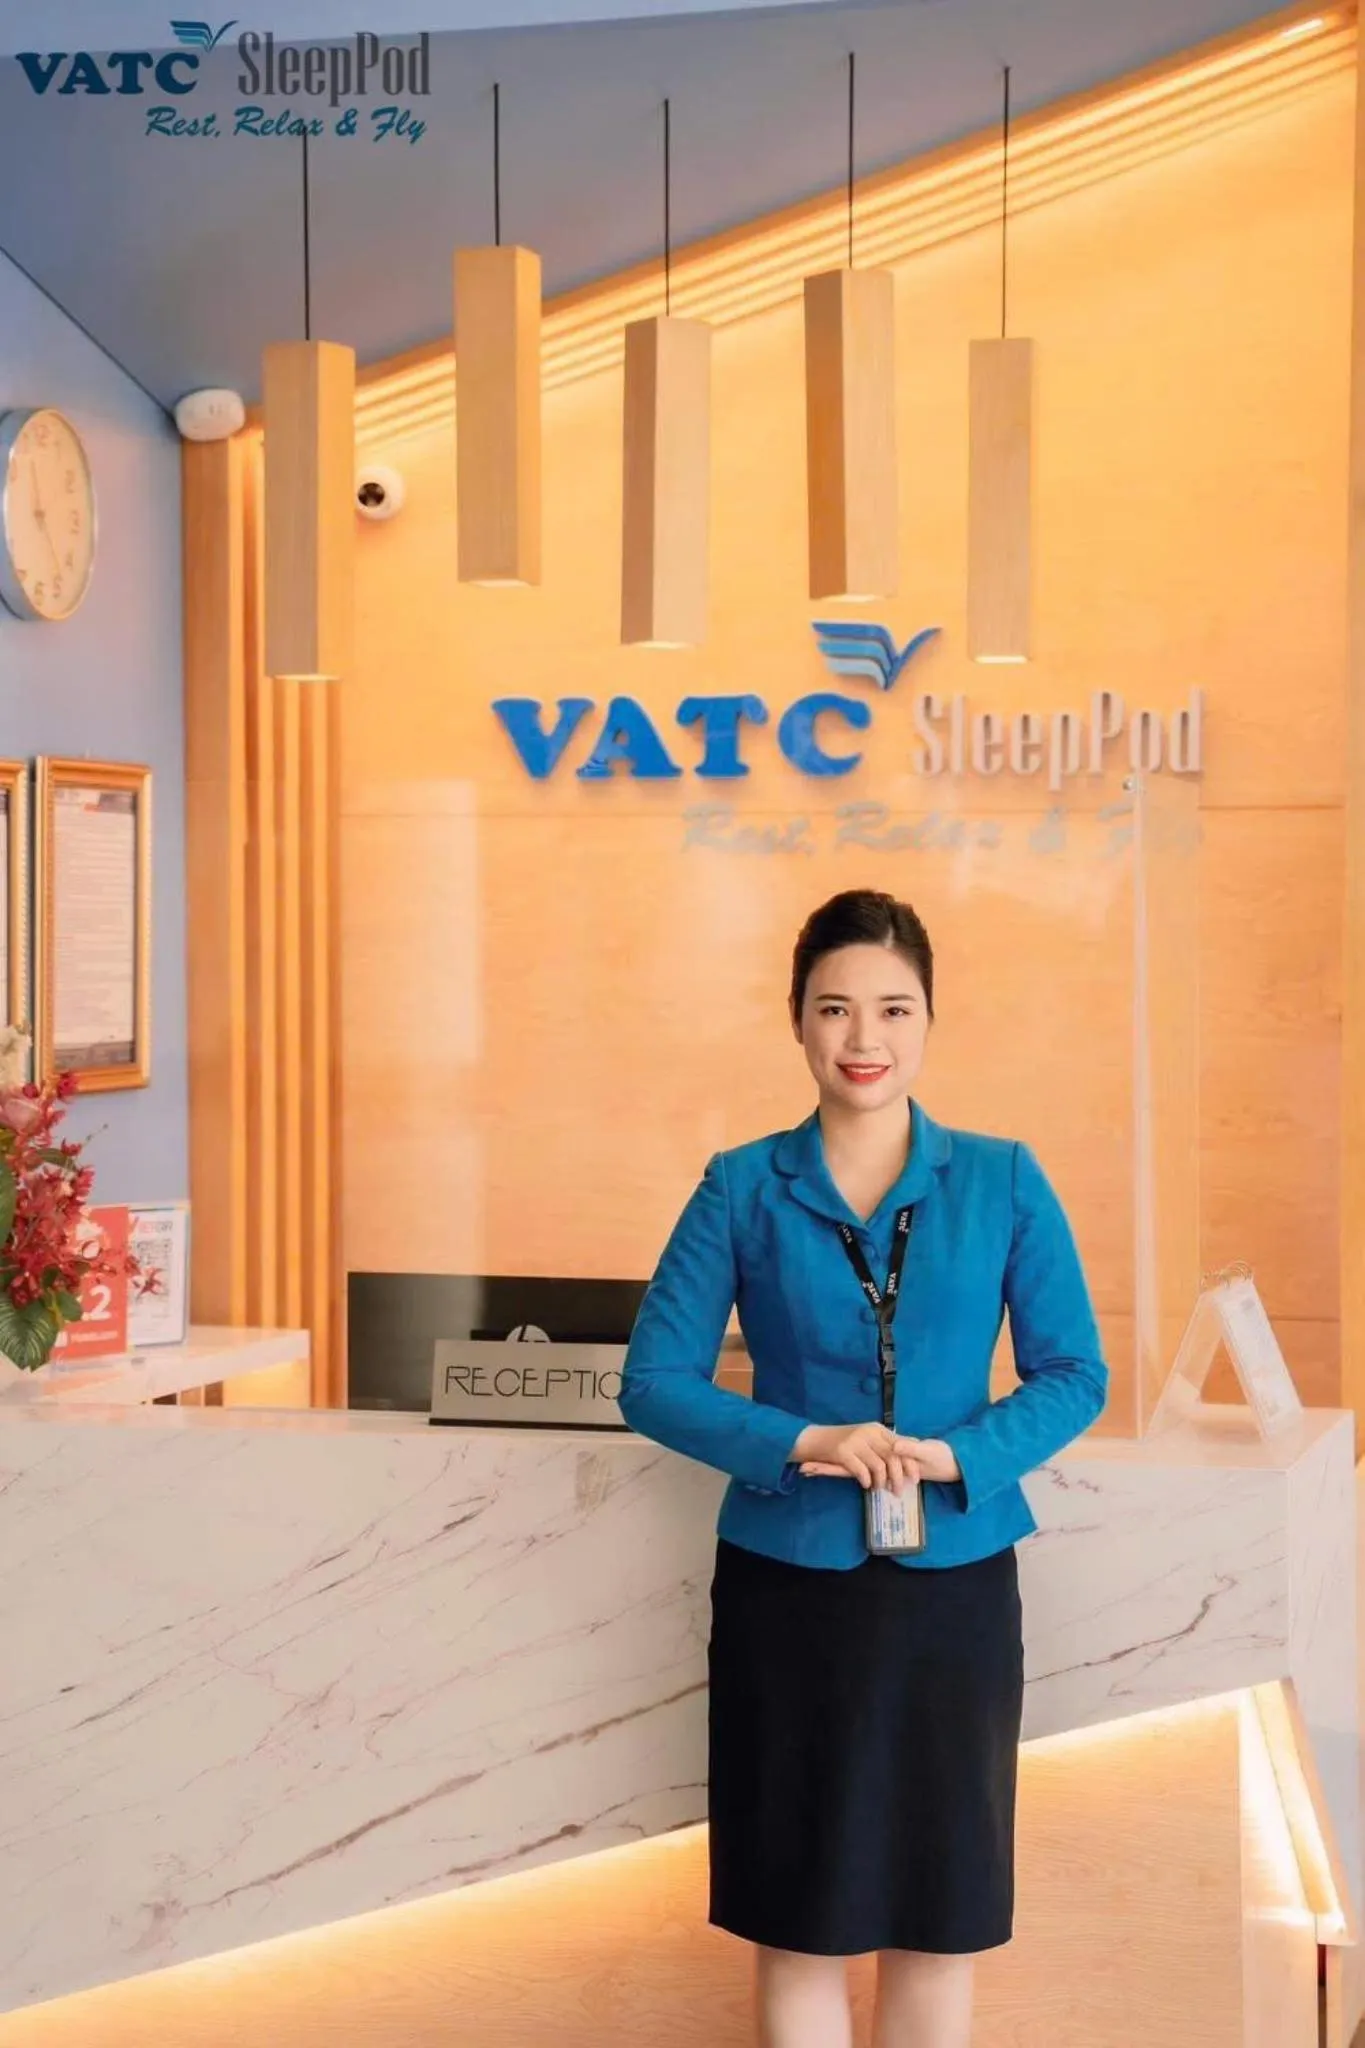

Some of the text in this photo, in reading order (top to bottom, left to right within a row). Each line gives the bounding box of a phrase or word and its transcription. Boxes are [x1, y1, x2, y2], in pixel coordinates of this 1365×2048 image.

[492, 684, 1203, 791] VATC SleepPod
[445, 1365, 624, 1400] RECEPTIO
